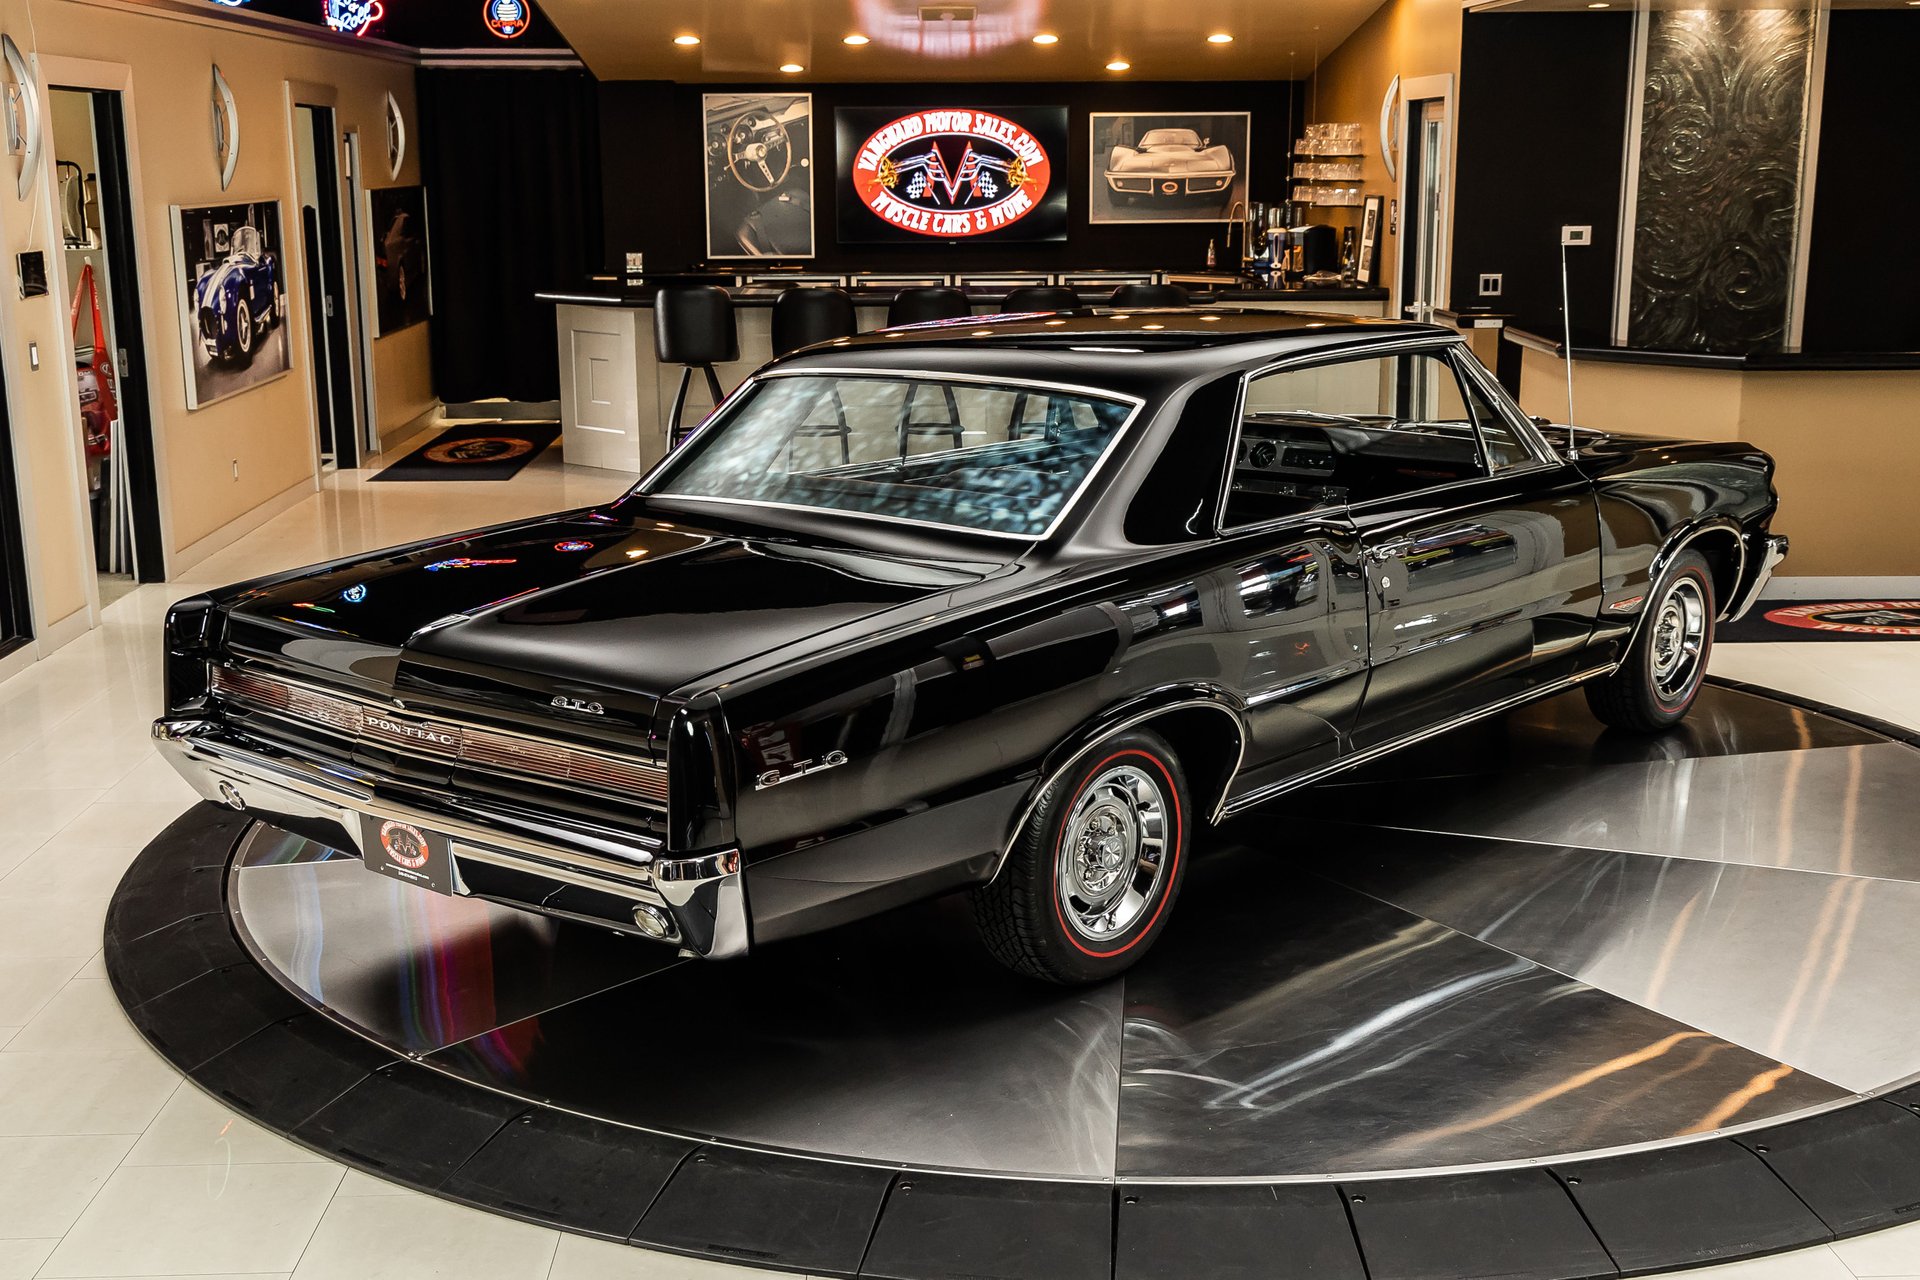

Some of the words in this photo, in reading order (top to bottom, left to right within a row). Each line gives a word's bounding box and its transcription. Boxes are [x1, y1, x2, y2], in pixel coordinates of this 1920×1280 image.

[857, 116, 924, 171] VANGUARD
[923, 111, 972, 133] MOTOR
[972, 113, 1044, 167] SALES.COM
[870, 191, 931, 231] MUSCLE
[932, 213, 971, 233] CARS
[974, 210, 987, 230] &
[988, 189, 1033, 226] MORE
[551, 695, 604, 714] GTO
[367, 716, 453, 744] PONTIAC
[755, 750, 848, 791] GTO
